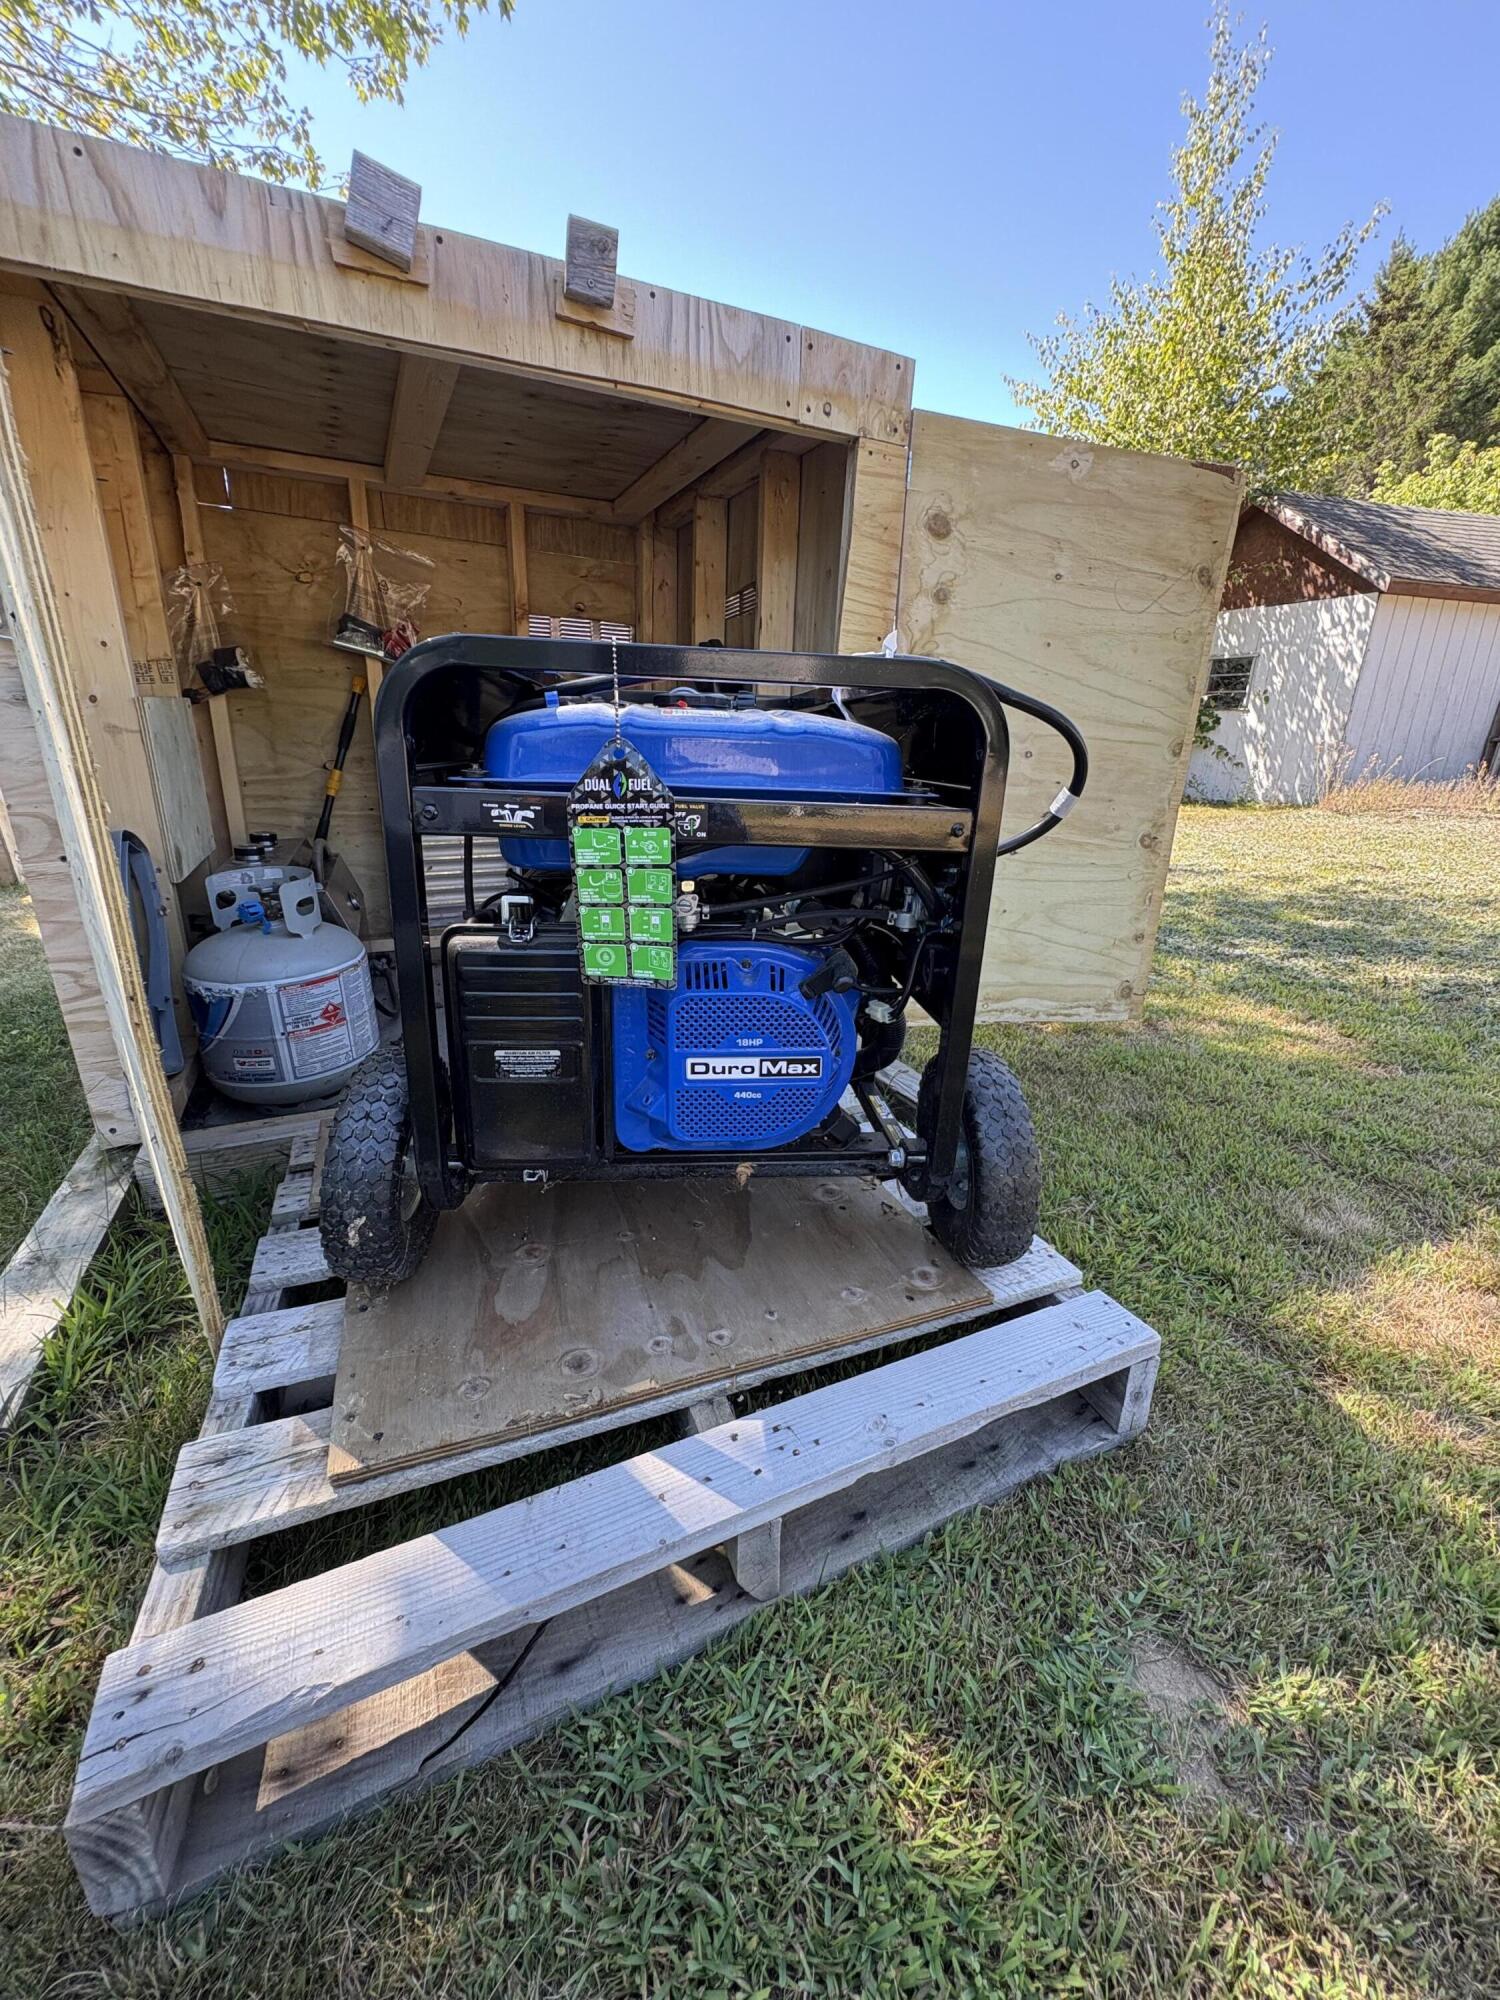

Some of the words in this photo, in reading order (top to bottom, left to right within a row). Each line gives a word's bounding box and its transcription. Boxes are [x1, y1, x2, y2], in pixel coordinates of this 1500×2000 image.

[584, 778, 612, 792] DUAL
[628, 778, 653, 792] FUEL
[735, 1038, 764, 1047] 18HP
[734, 1091, 762, 1099] 440cc
